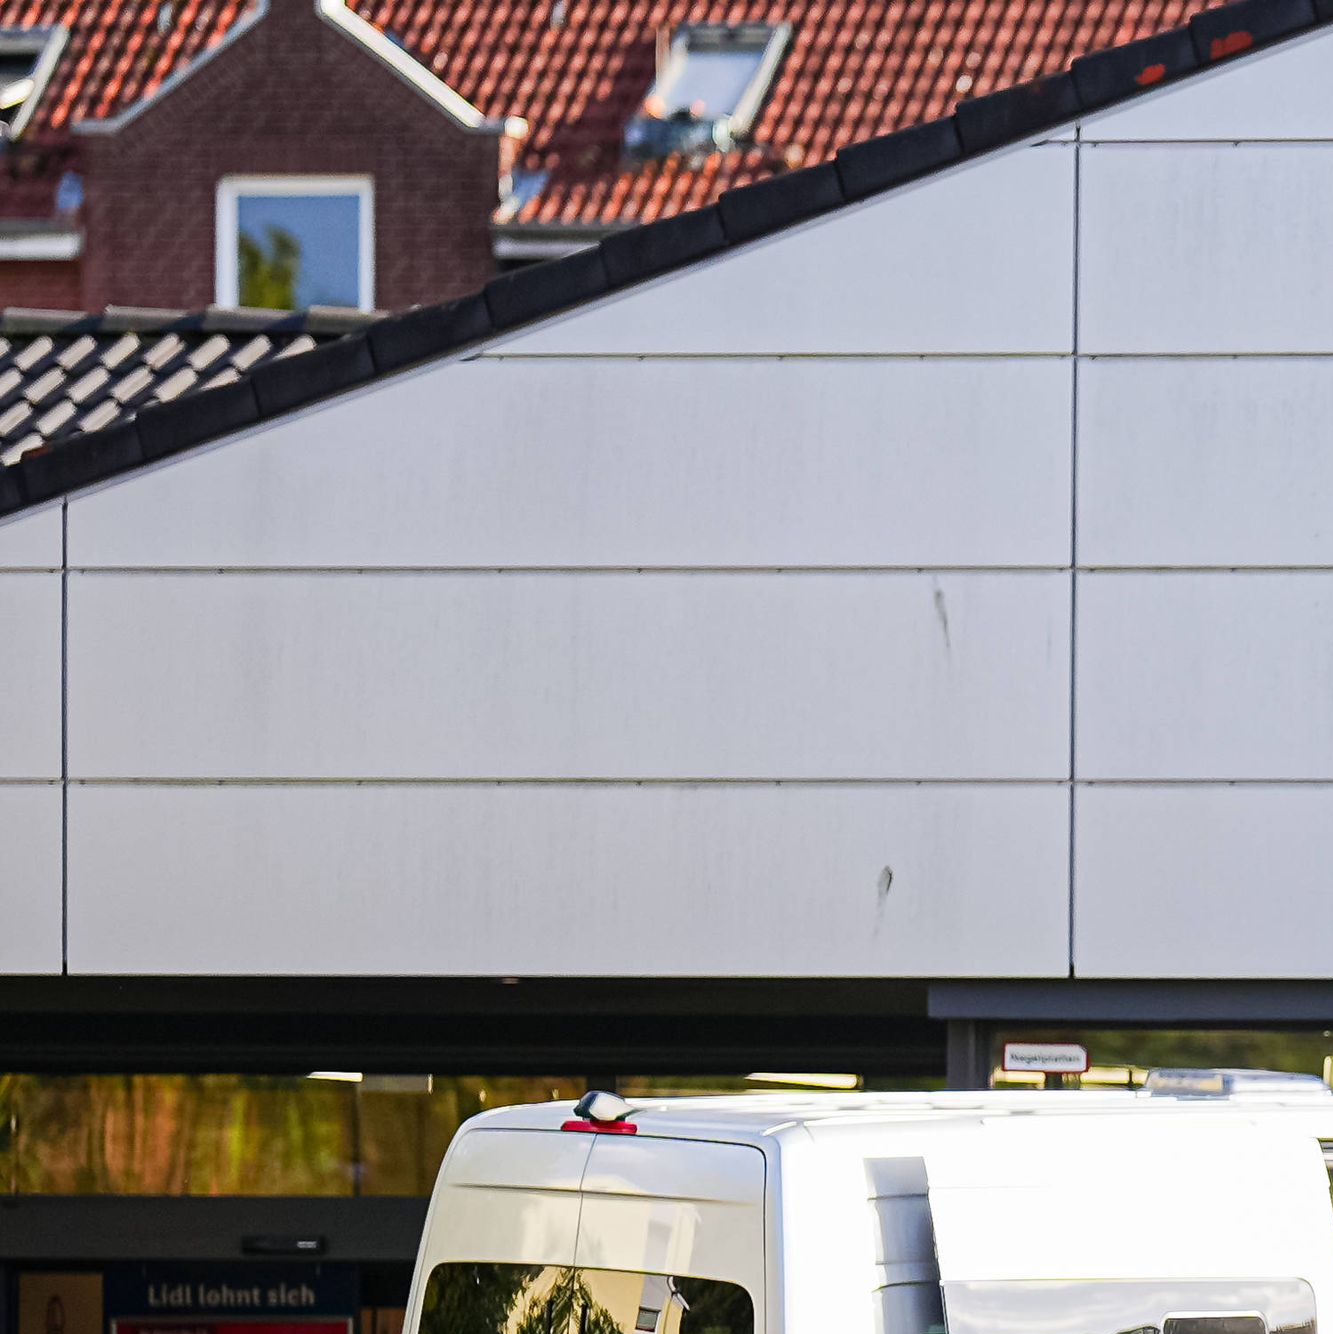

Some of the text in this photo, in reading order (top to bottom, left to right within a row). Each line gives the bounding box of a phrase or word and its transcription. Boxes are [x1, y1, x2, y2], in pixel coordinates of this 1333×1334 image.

[148, 1282, 316, 1307] Lidl lohnt sich
